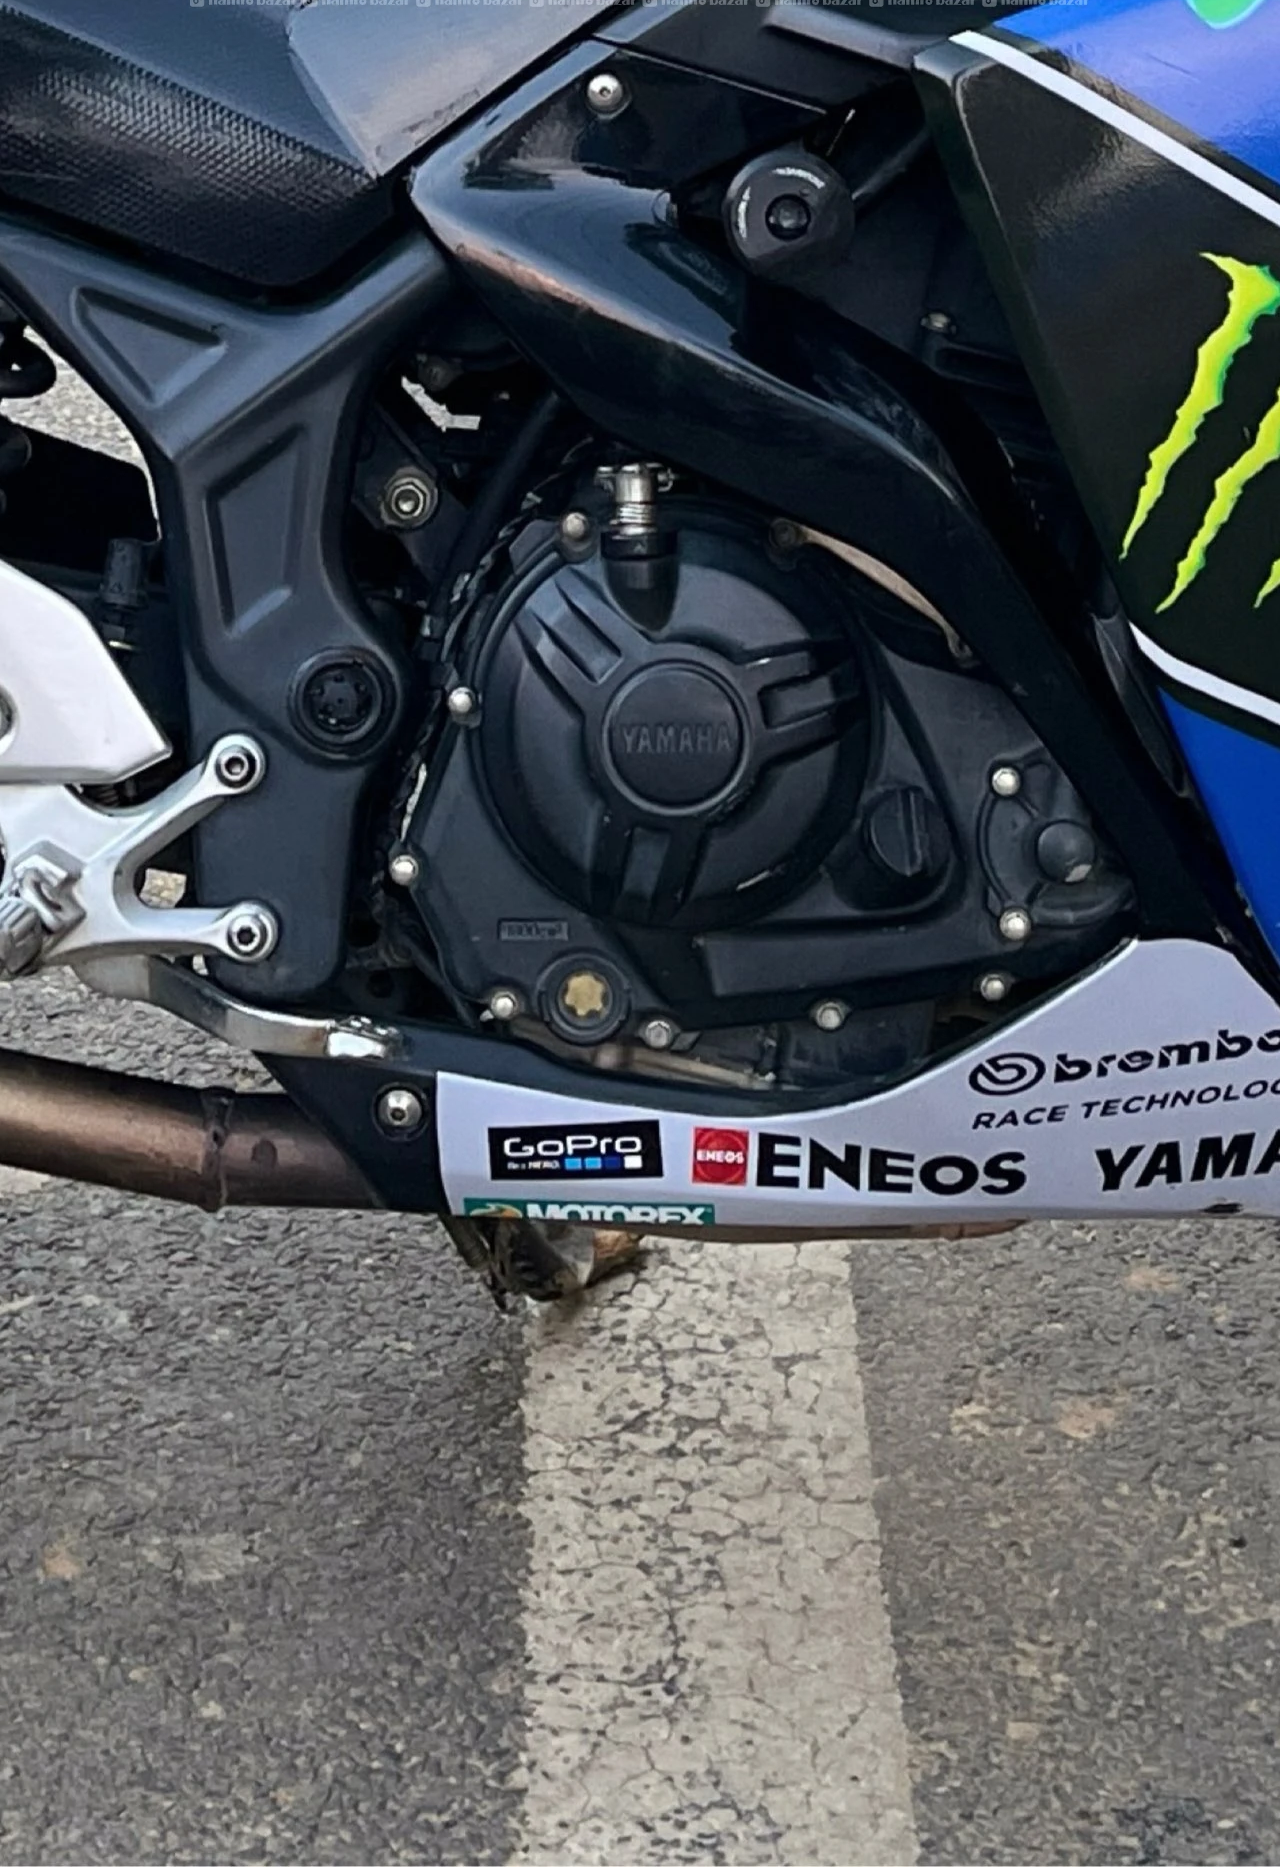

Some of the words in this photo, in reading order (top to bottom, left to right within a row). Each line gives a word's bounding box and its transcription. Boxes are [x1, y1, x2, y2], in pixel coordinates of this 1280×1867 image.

[622, 724, 731, 754] YAMAHA
[971, 1103, 1070, 1131] RACE
[503, 1135, 642, 1157] GoPro
[696, 1149, 744, 1164] ENEOS
[755, 1131, 1027, 1197] ENEOS
[526, 1203, 705, 1226] MOTOREX
